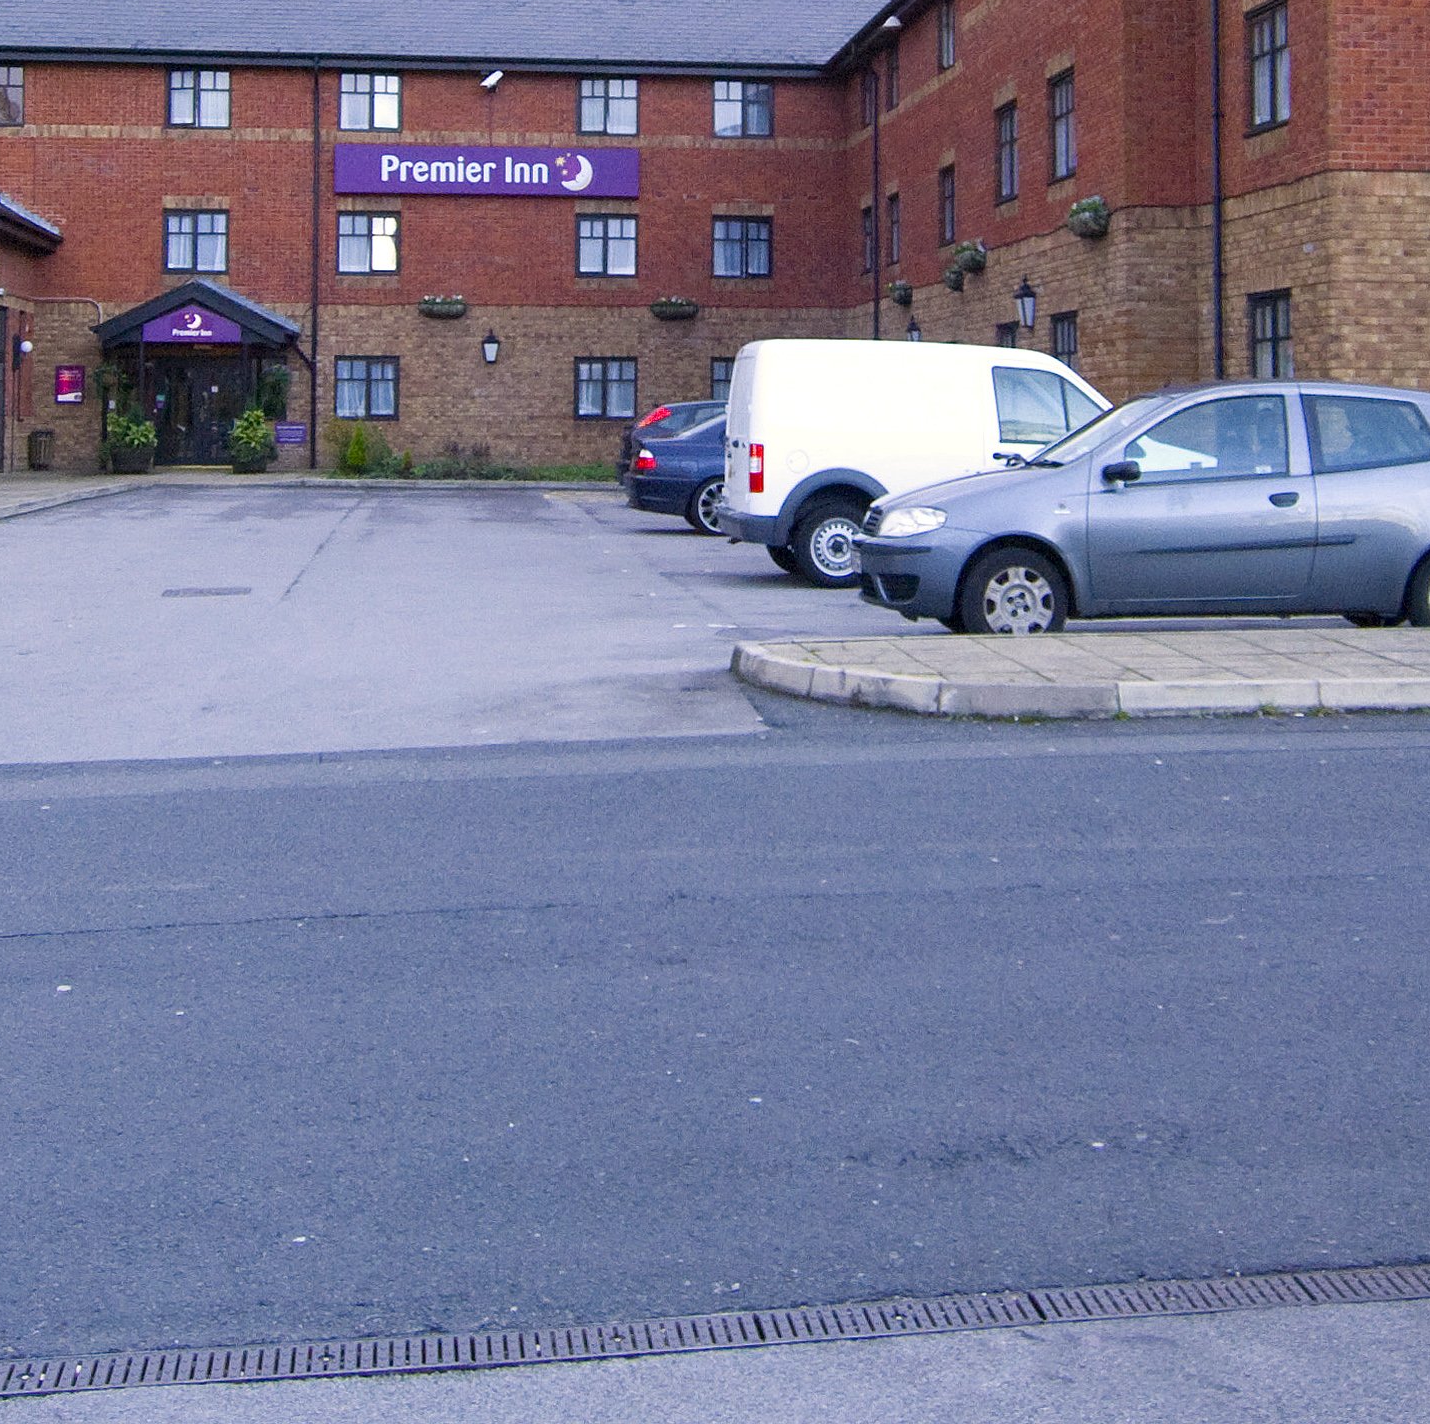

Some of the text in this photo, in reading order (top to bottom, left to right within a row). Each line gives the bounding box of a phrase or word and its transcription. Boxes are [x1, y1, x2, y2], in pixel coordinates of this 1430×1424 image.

[381, 154, 549, 184] Premier Inn
[172, 328, 199, 336] Premier
